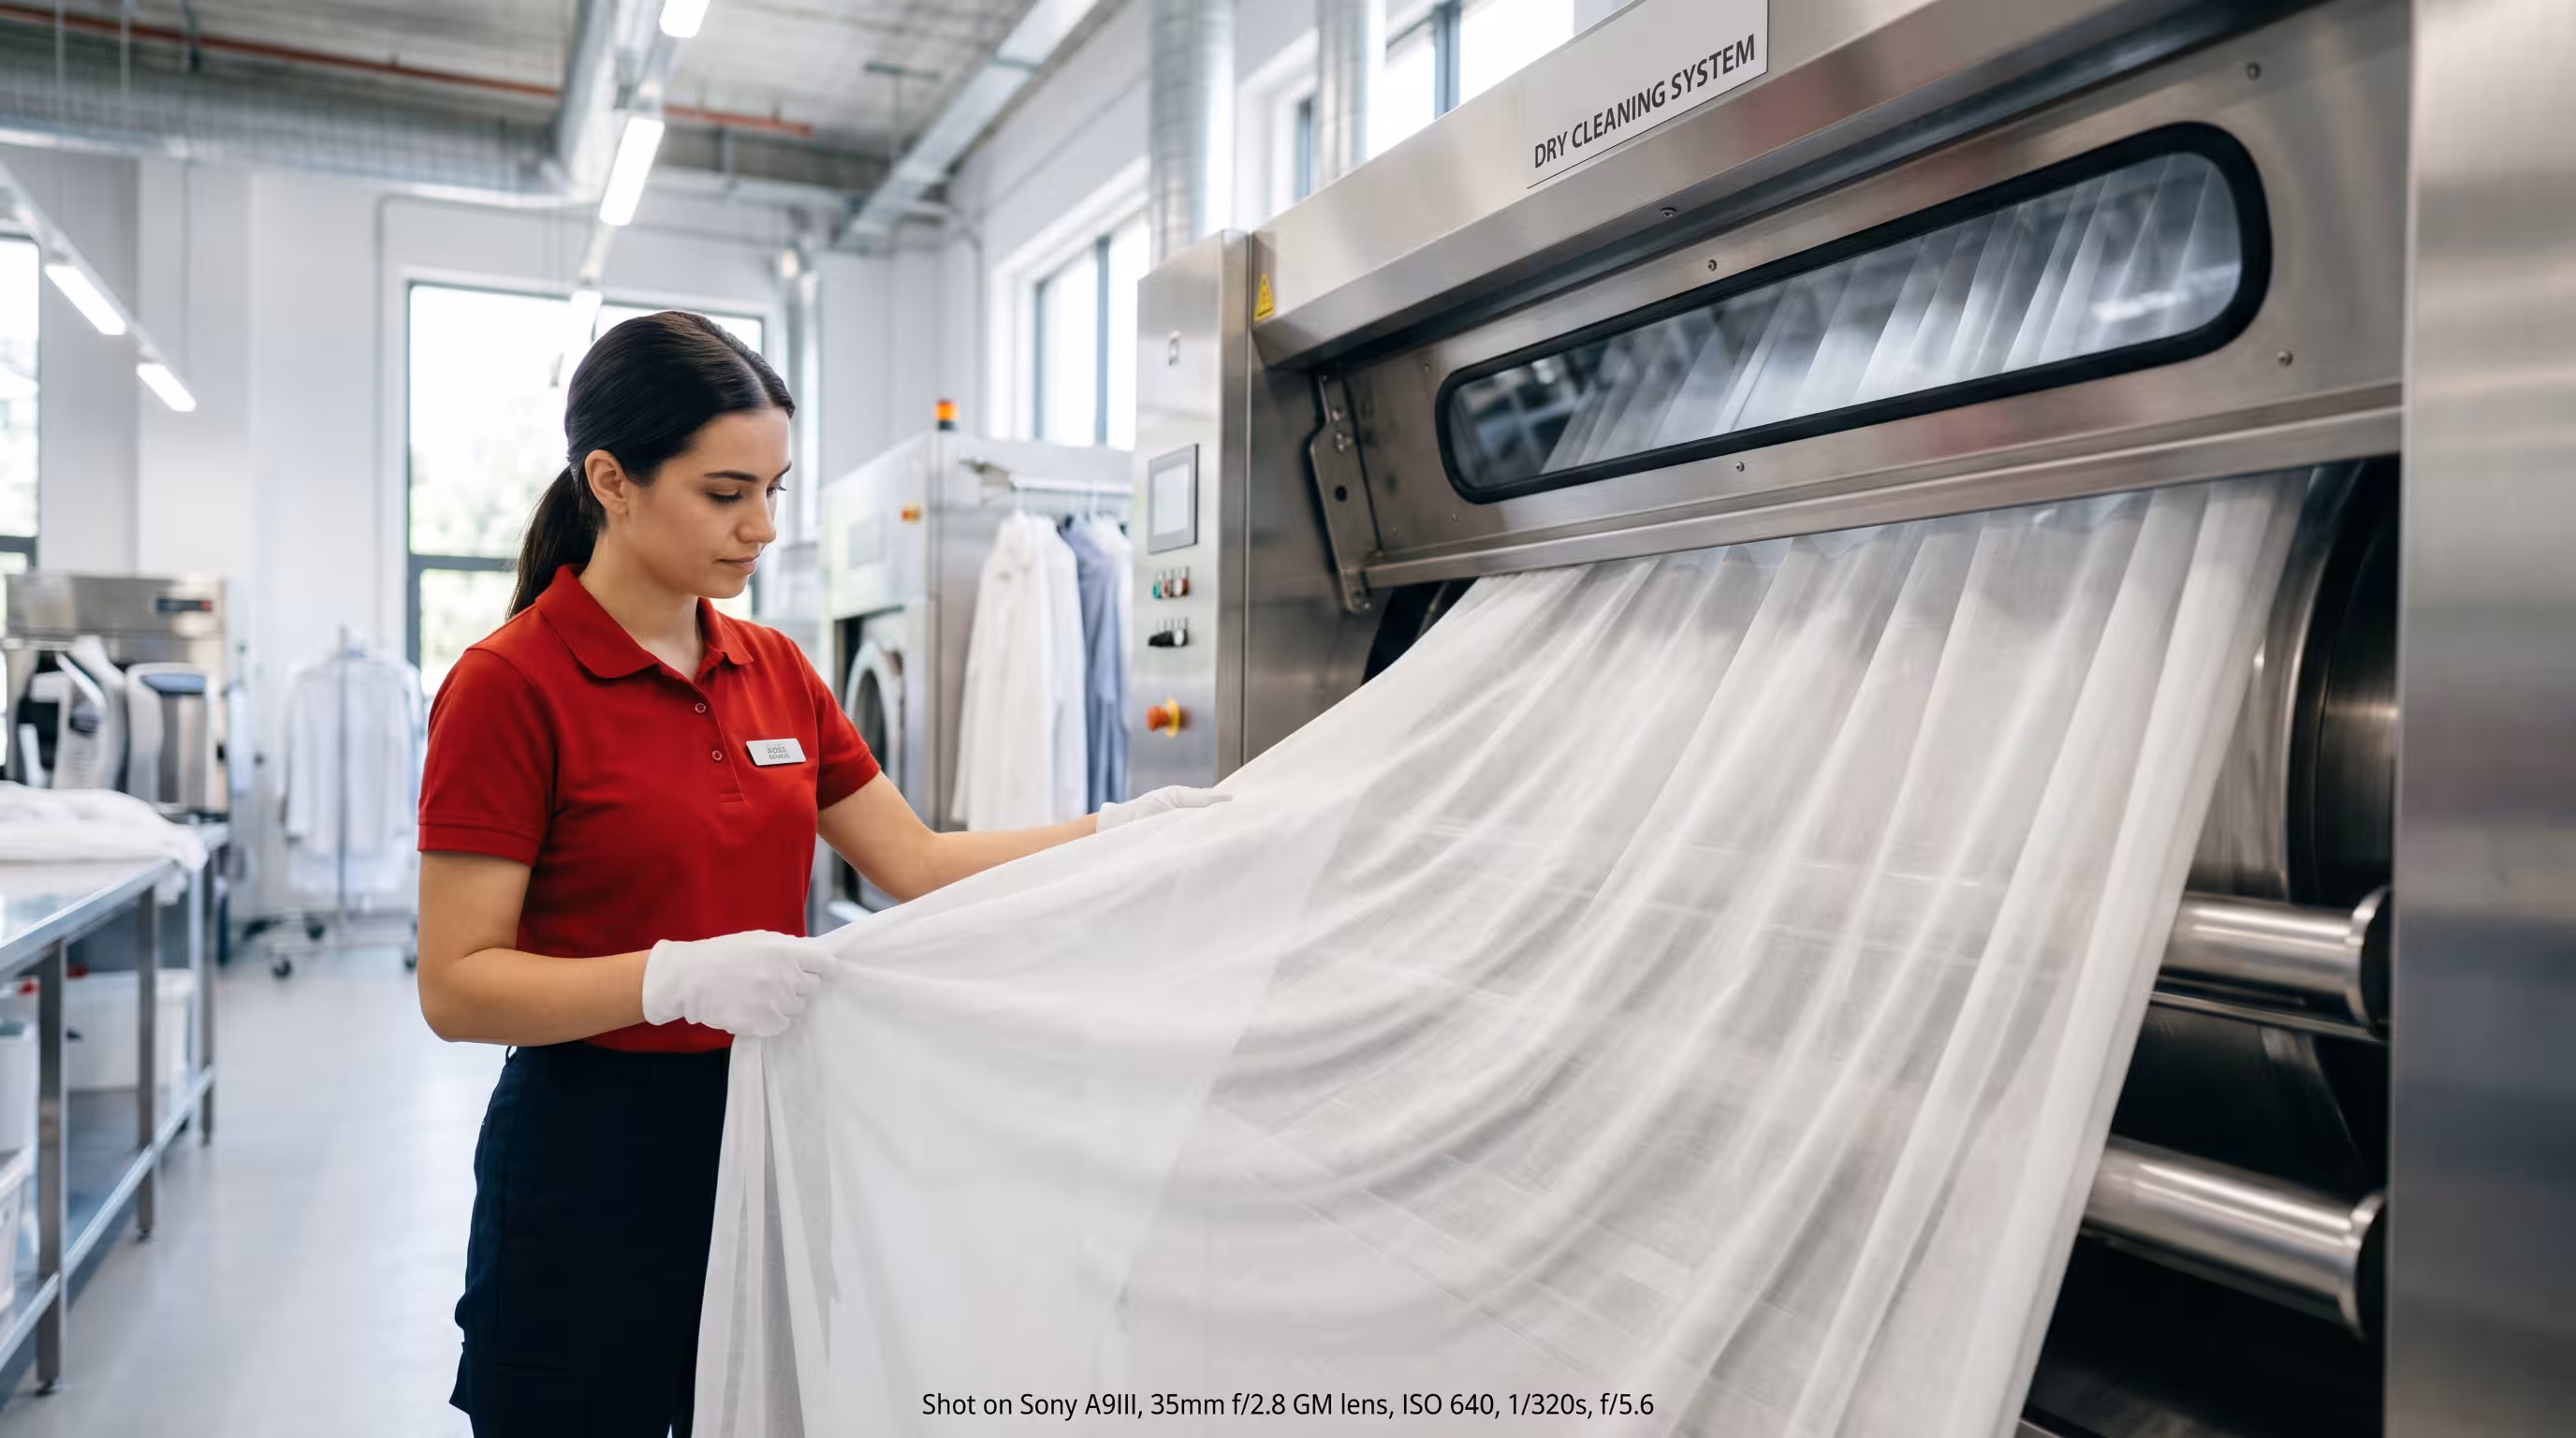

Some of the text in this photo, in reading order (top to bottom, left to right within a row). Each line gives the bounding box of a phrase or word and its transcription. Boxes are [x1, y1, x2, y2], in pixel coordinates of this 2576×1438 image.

[1535, 34, 1755, 169] DRY CLEANING SYSTEM
